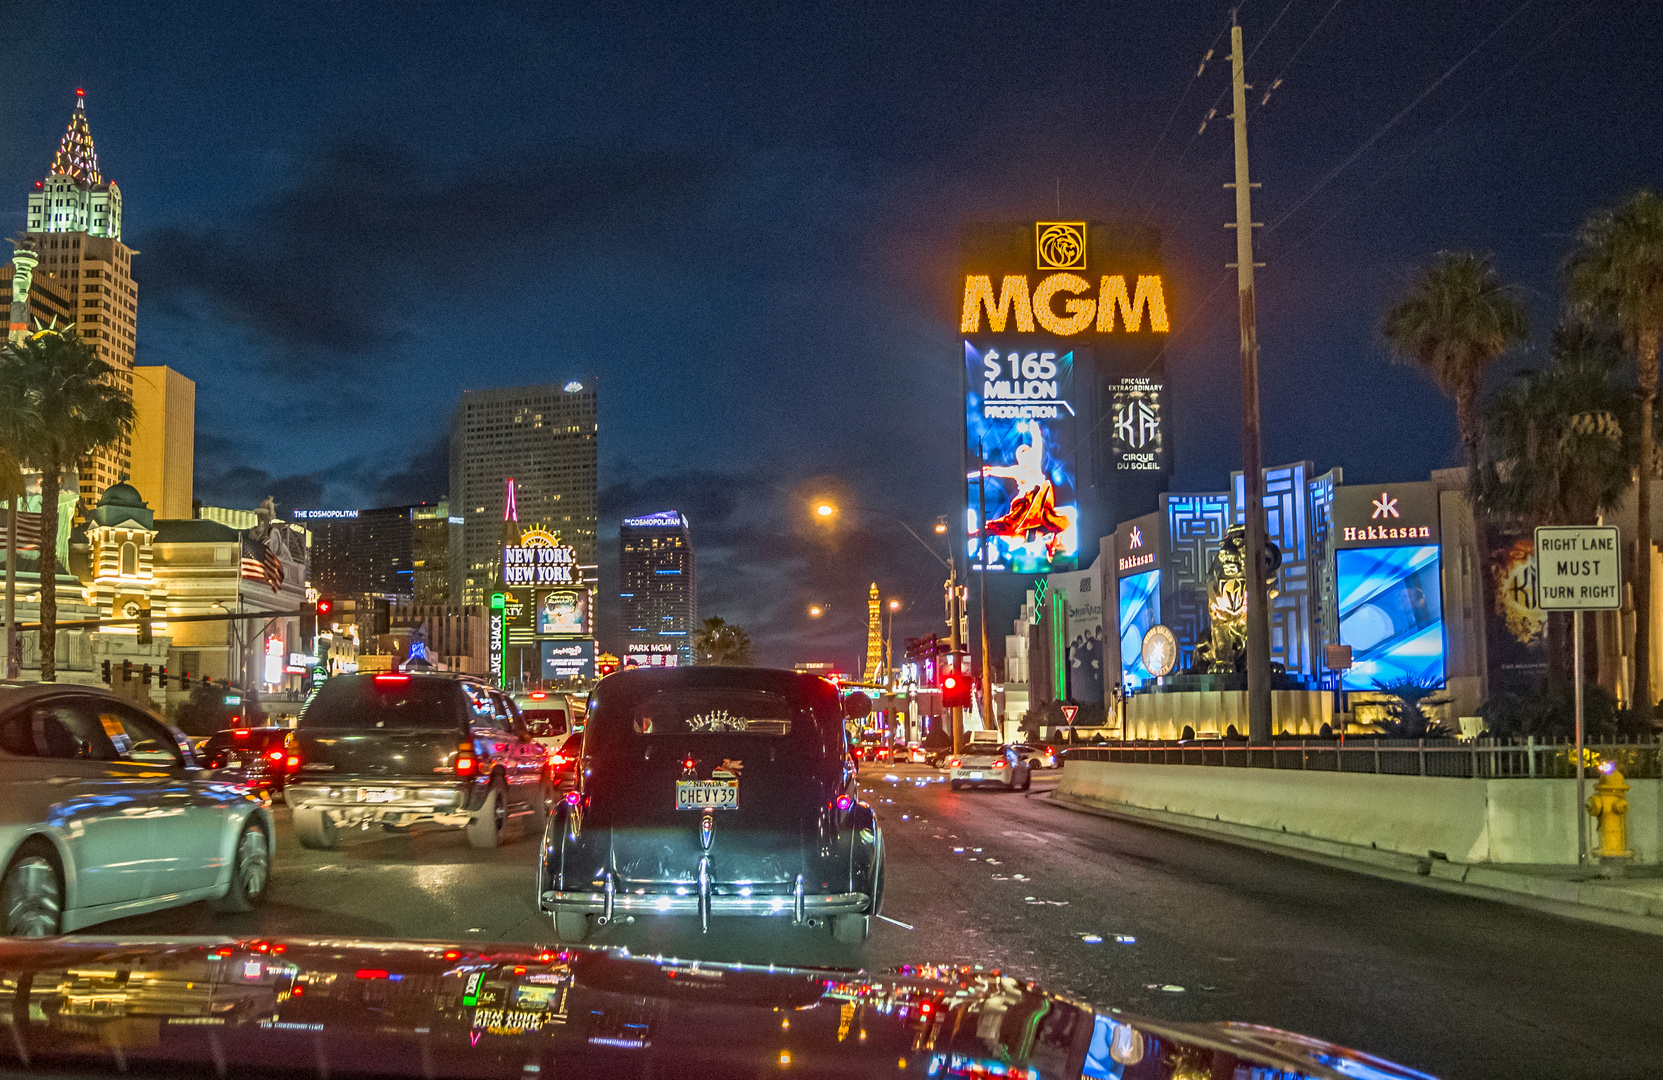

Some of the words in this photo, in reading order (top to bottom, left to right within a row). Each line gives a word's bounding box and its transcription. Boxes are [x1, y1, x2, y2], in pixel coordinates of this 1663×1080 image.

[961, 272, 1170, 336] MGM
[984, 380, 1057, 399] MILLION
[1108, 384, 1163, 392] EXTRAORDINARY
[984, 405, 1057, 419] PRODUCTION
[1122, 453, 1154, 463] CIRQUE
[1117, 462, 1129, 470] DU
[1131, 462, 1160, 470] SOLEIL
[294, 510, 308, 518] THE
[308, 510, 359, 518] COSMOPOLITAN
[630, 518, 681, 526] COSMOPOLITAN
[1344, 526, 1430, 541] Hakkasan
[1541, 538, 1577, 551] RIGHT
[1582, 537, 1614, 550] LANE
[505, 548, 536, 564] NEW
[537, 548, 572, 563] YORK
[1119, 553, 1155, 570] Hakkasan
[505, 566, 536, 582] NEW
[537, 566, 572, 581] YORK
[1557, 560, 1601, 576] MUST
[1542, 586, 1575, 599] TURN
[1580, 585, 1616, 598] RIGHT
[491, 615, 502, 651] SHACK
[629, 643, 650, 652] PARK
[650, 643, 672, 652] MGM
[680, 789, 735, 803] CHEVY39
